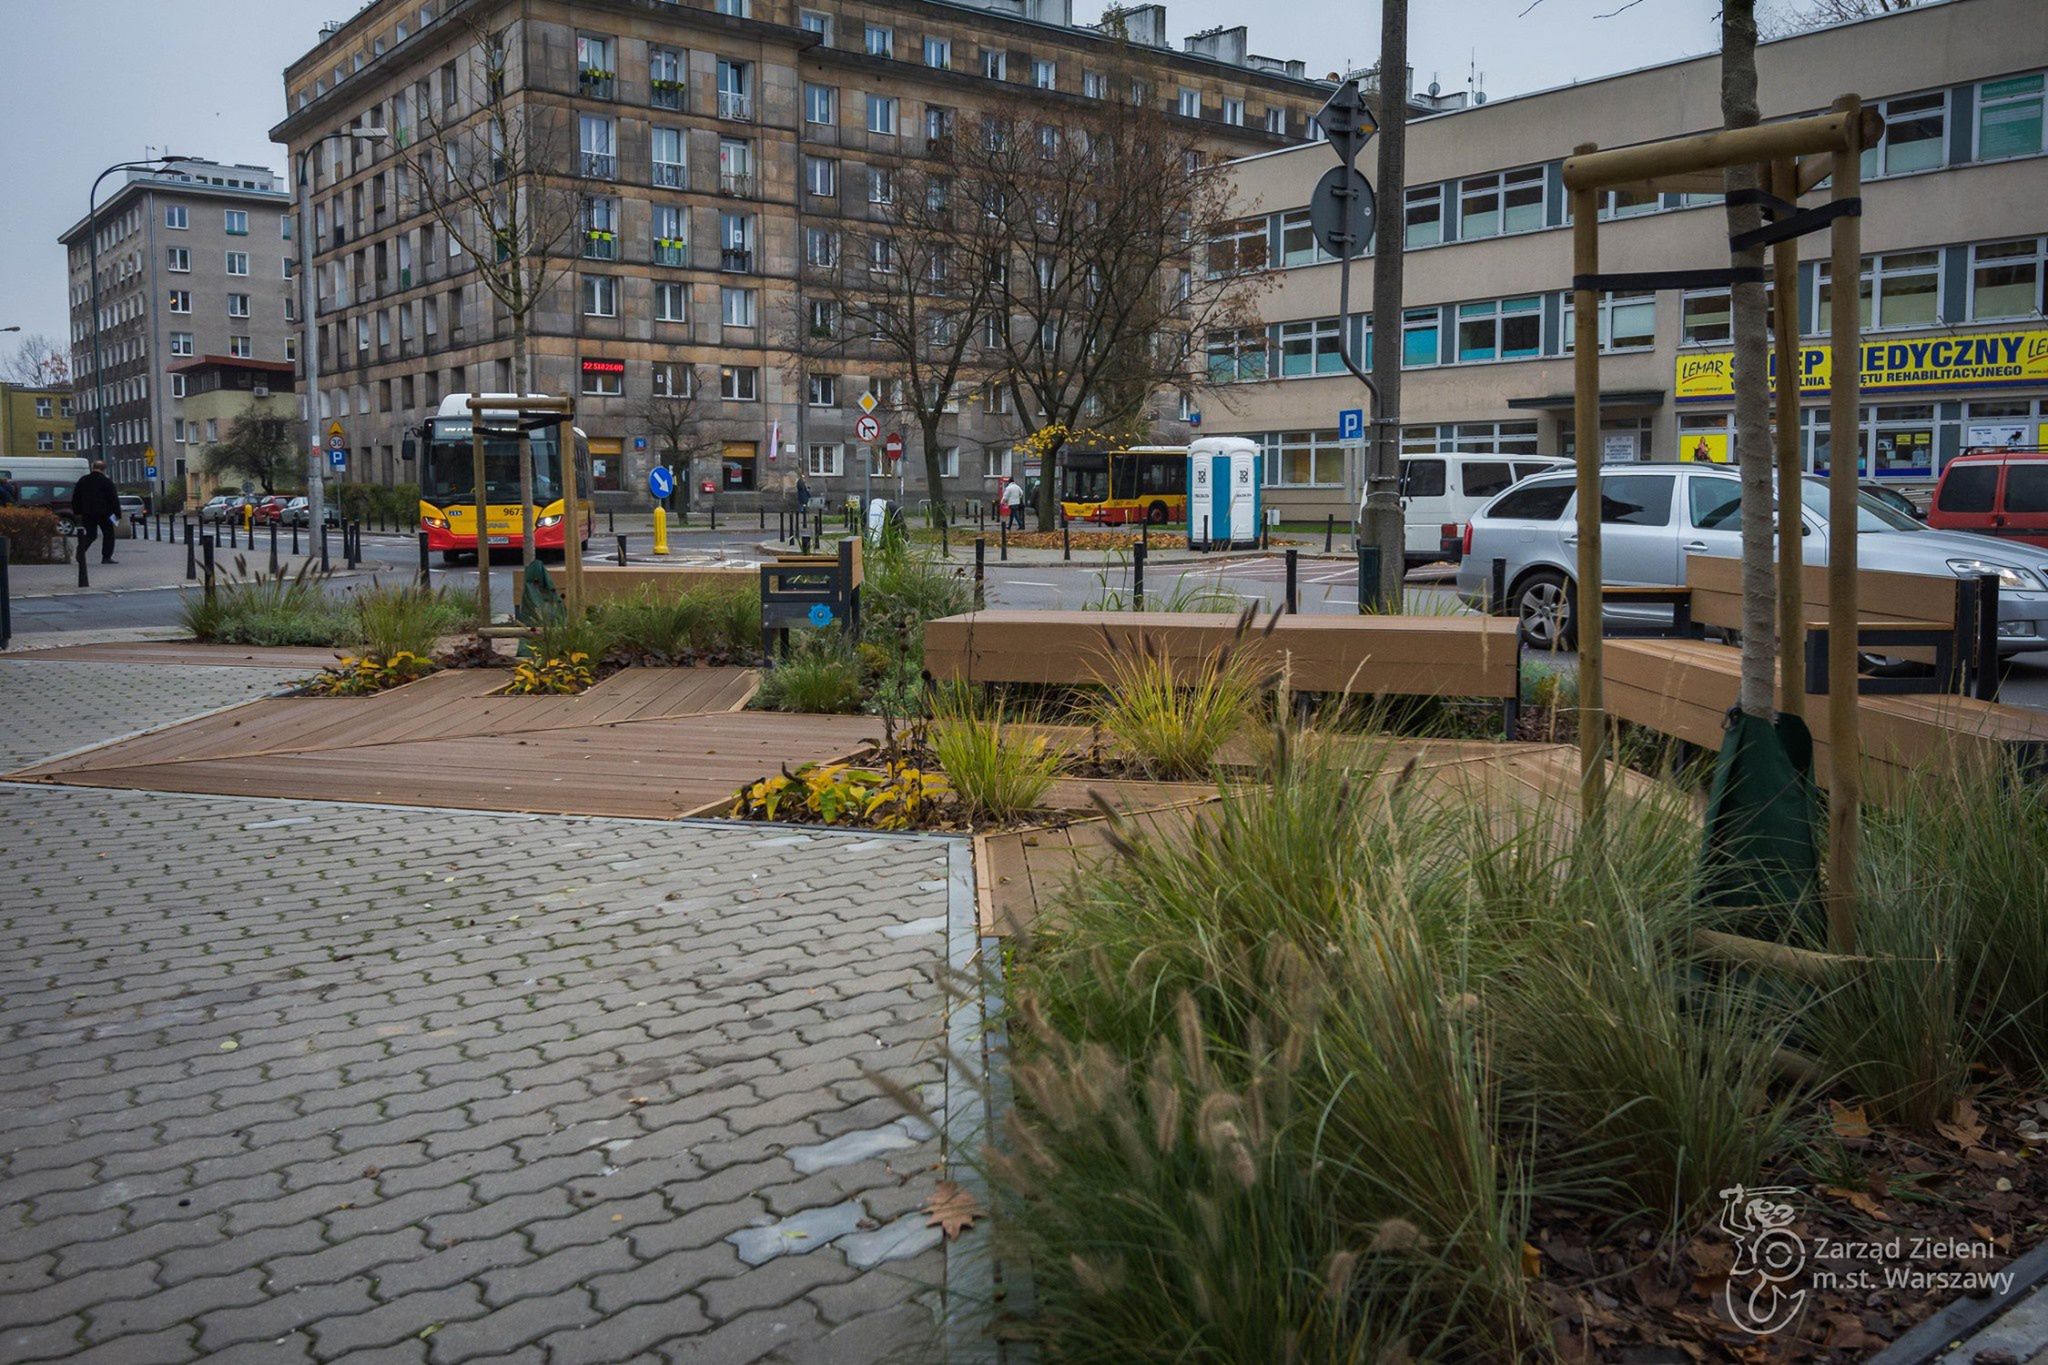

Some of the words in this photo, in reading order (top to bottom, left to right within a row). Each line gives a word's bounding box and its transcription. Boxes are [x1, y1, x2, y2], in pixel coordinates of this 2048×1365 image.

[1860, 336, 2025, 372] EDYCZNY
[1682, 360, 1724, 379] LEMAR
[1887, 365, 2023, 382] REHABILITACYJNEGO
[1345, 414, 1358, 438] P
[333, 451, 343, 464] P
